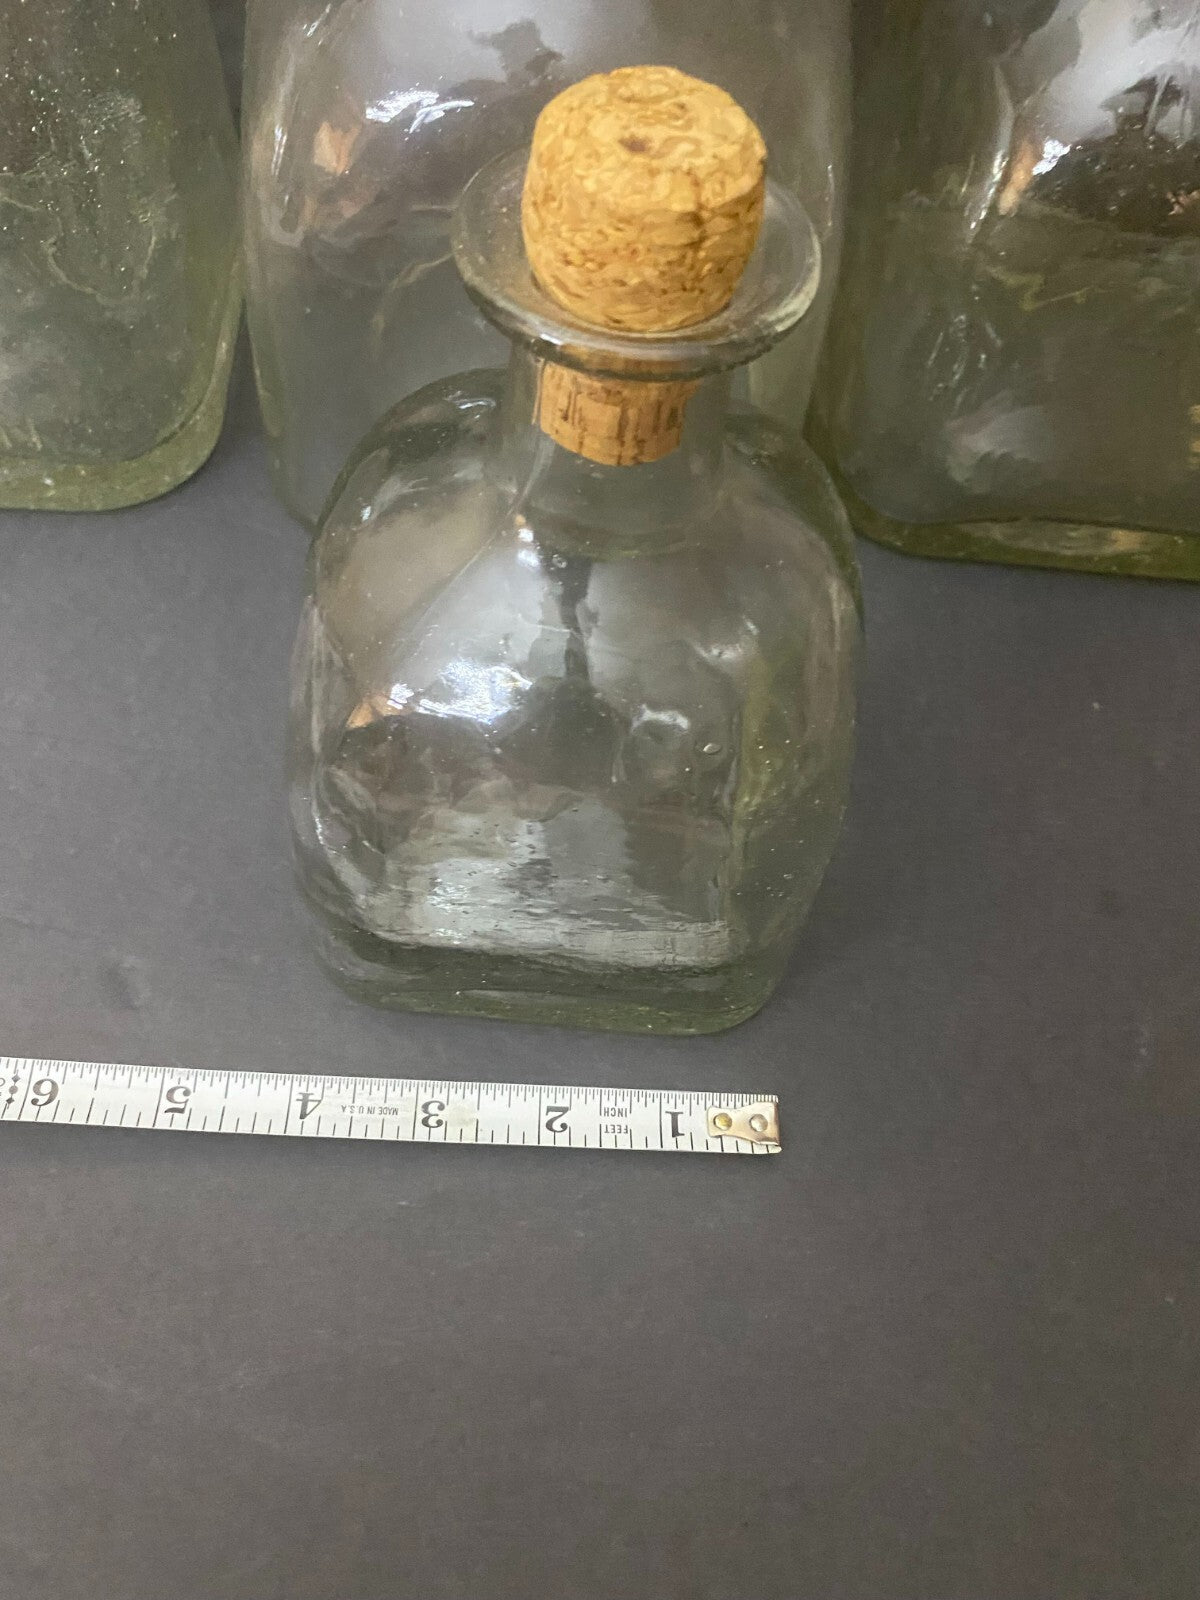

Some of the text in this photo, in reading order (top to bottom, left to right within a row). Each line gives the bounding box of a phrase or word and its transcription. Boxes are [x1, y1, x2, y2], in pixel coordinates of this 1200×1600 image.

[30, 1078, 59, 1107] 6
[164, 1085, 192, 1115] 5
[296, 1092, 324, 1120] 4
[367, 1106, 377, 1115] IN
[378, 1107, 399, 1116] MADE
[421, 1100, 445, 1128] 3
[545, 1105, 570, 1133] 2
[603, 1107, 628, 1118] INCH
[604, 1124, 629, 1134] FEET
[665, 1111, 685, 1138] 1
